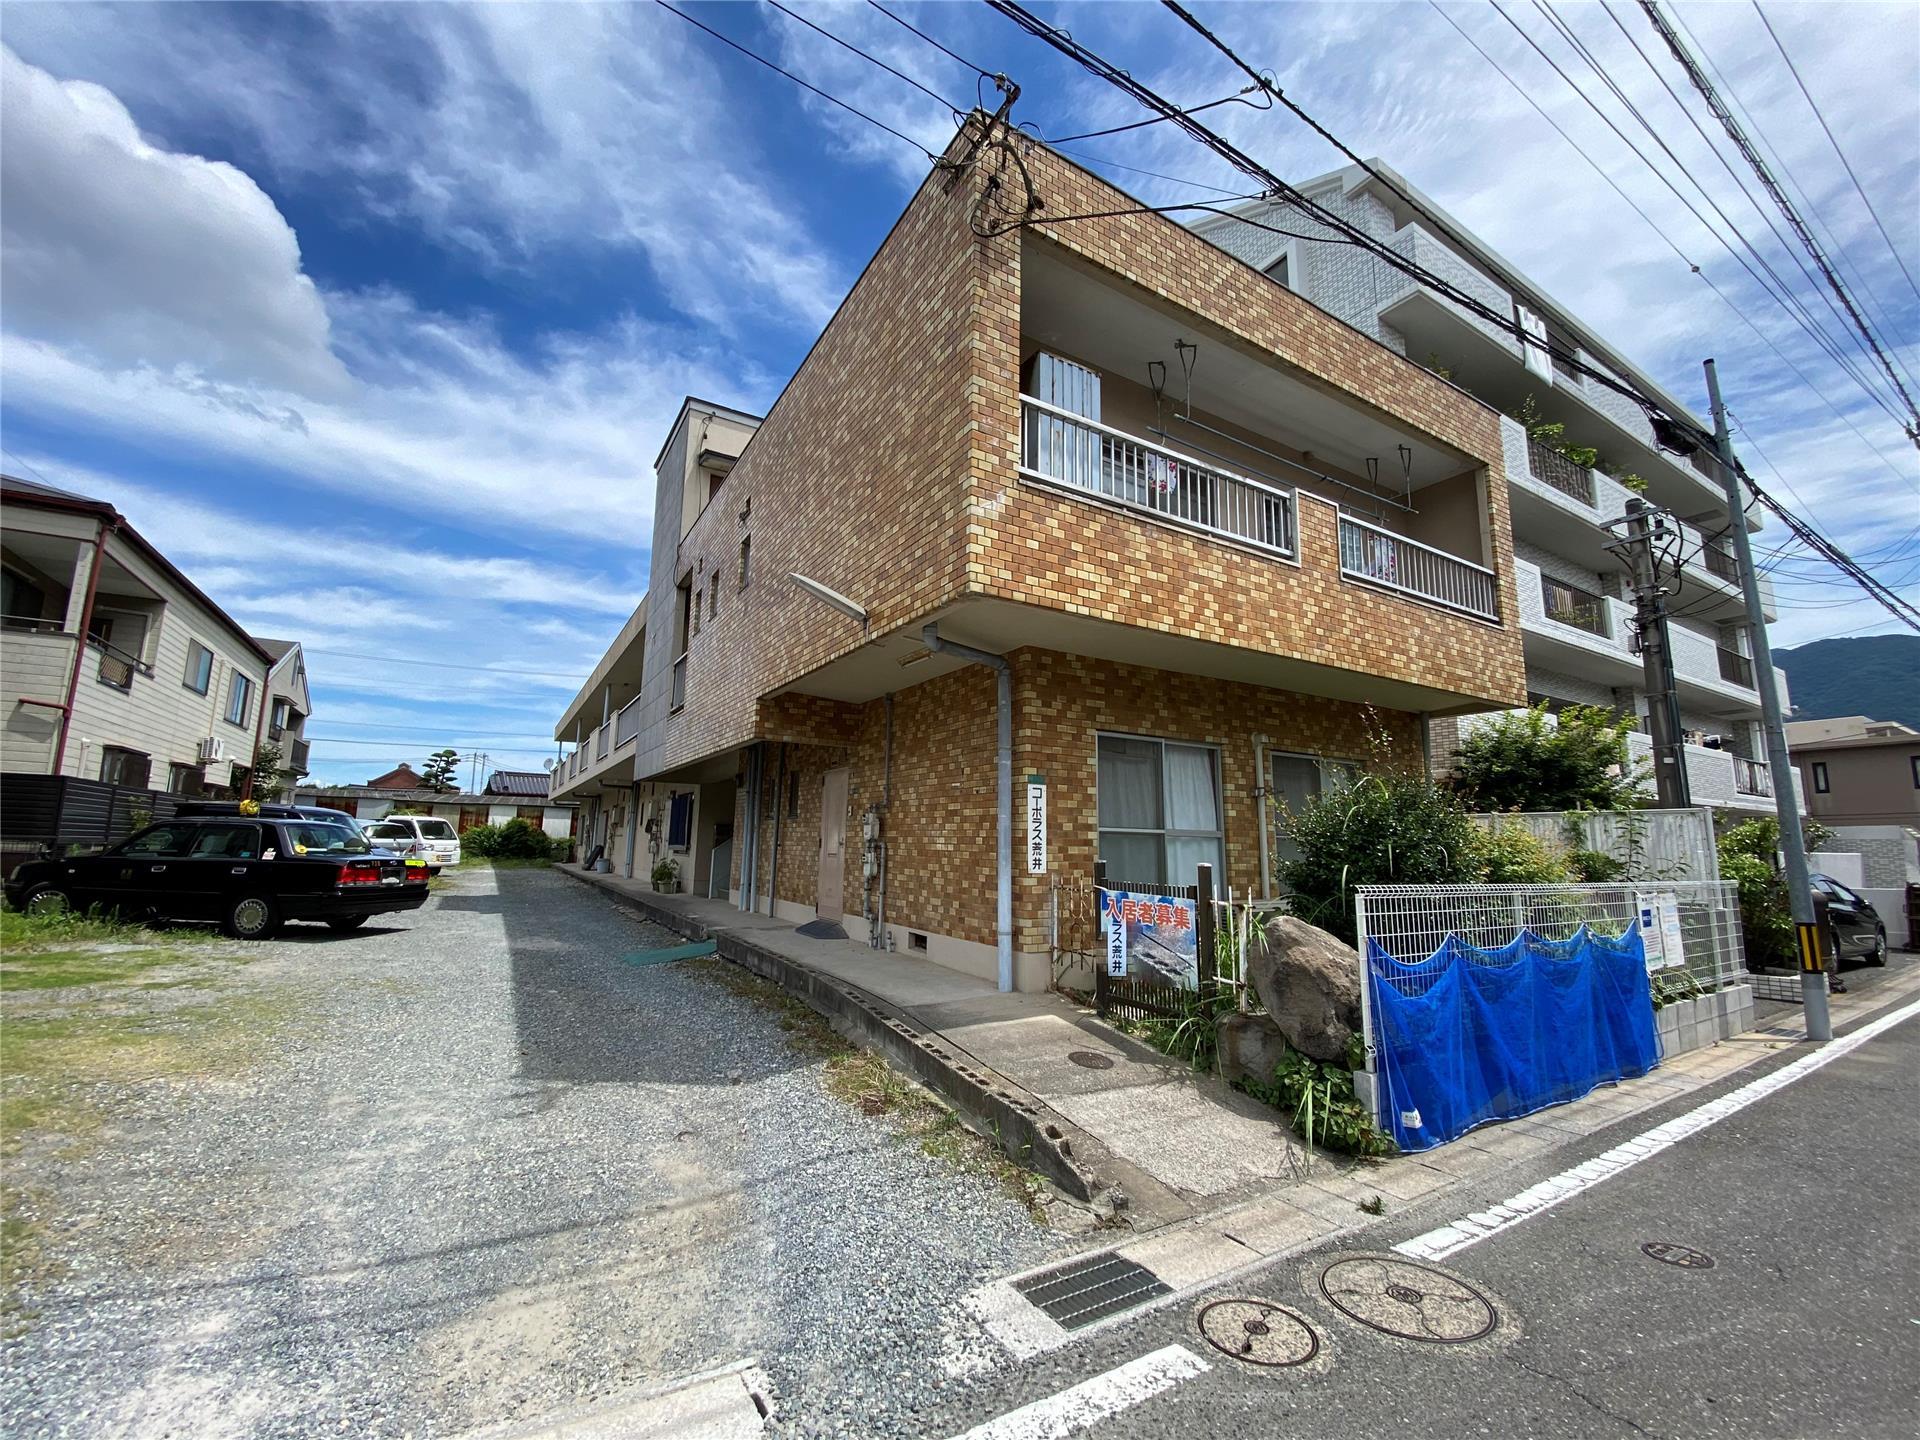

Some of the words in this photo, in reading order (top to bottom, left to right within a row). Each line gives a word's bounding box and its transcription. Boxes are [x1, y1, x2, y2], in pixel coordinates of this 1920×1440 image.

[1105, 897, 1192, 931] 入居者募集
